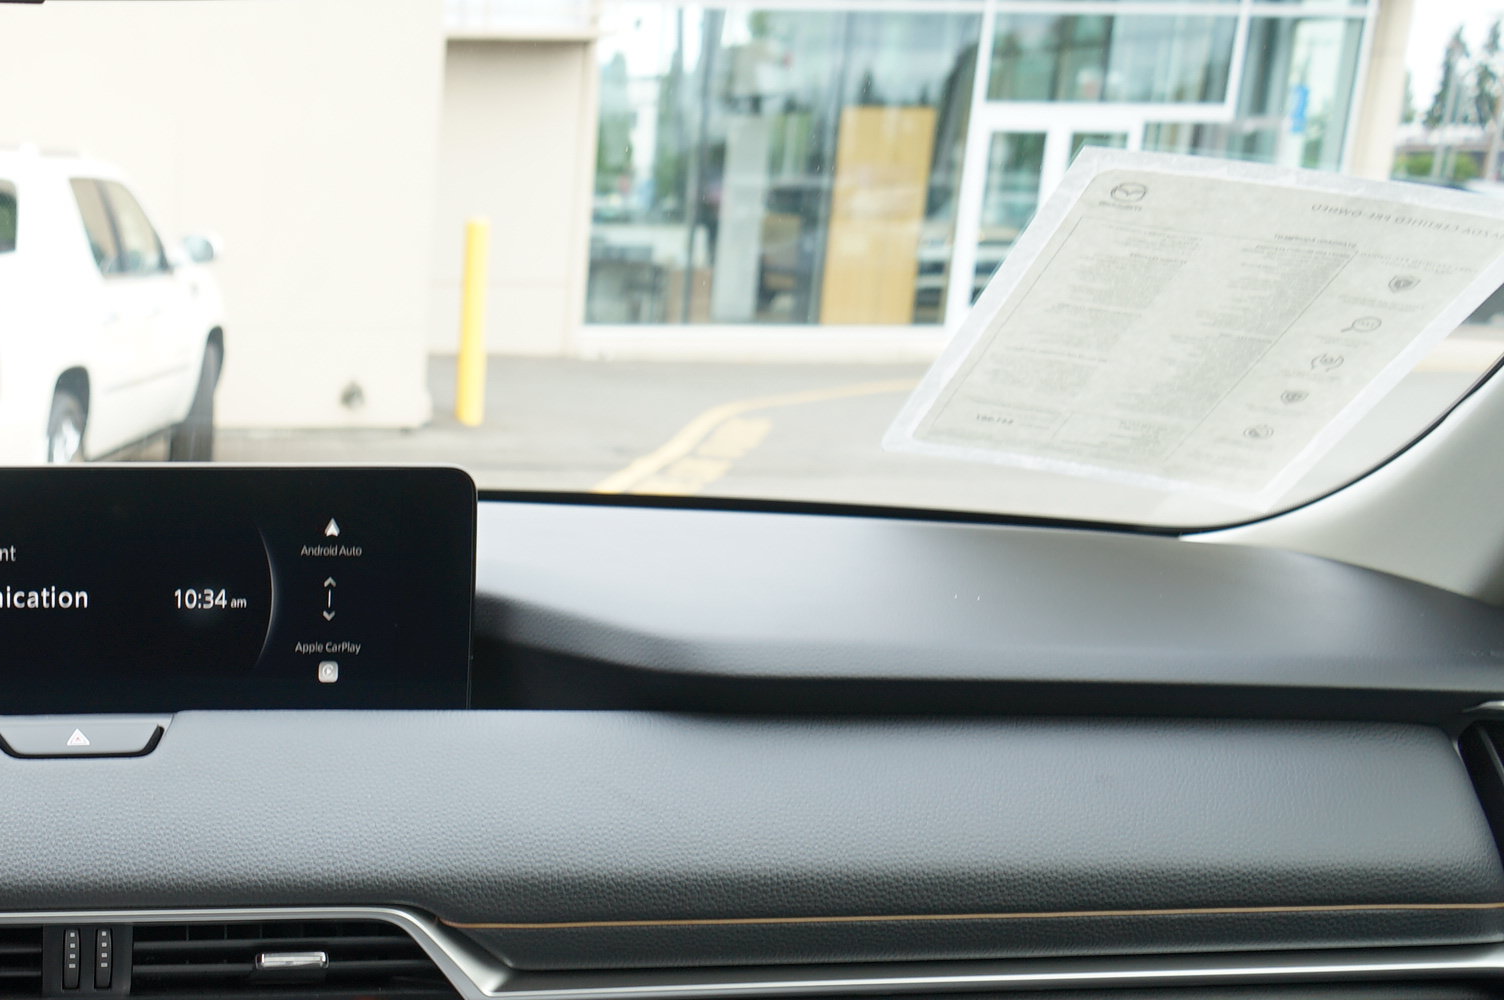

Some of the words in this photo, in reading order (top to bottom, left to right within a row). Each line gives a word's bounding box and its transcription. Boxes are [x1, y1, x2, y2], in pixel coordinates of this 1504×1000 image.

[300, 545, 338, 557] Android
[339, 545, 363, 557] Auto
[174, 588, 227, 609] 10:34
[230, 597, 247, 609] am
[295, 641, 324, 655] Apple
[325, 641, 362, 656] CarPlay
